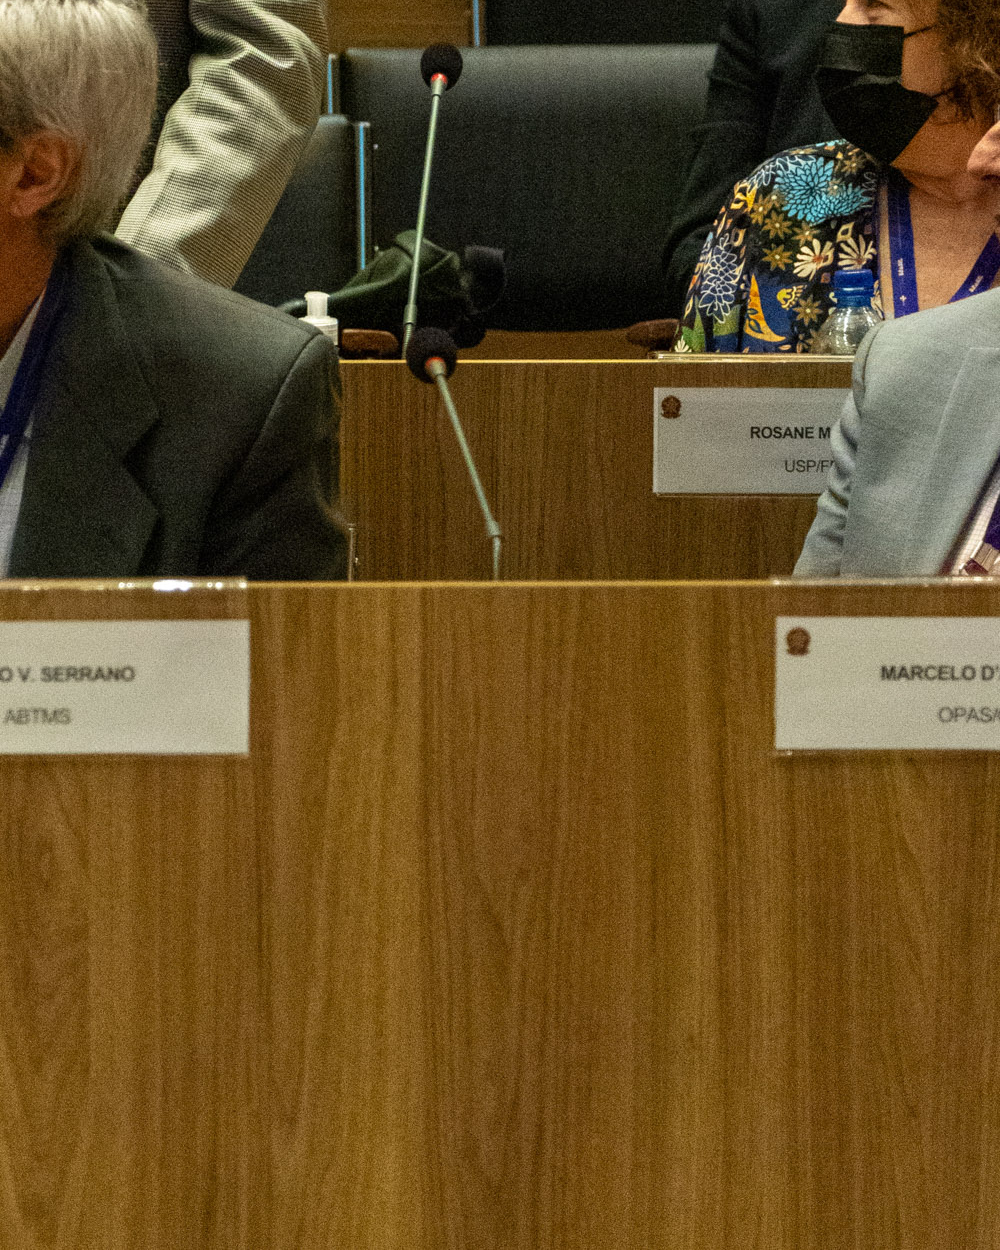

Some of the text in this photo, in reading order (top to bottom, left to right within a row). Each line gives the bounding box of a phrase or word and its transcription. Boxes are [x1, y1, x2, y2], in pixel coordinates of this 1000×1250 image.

[750, 426, 815, 439] ROSANE
[784, 459, 835, 473] USP/F
[16, 666, 34, 682] V.
[40, 665, 136, 682] SERRANO
[880, 664, 977, 681] MARCELO
[2, 706, 71, 724] ABTMS
[937, 706, 1000, 724] OPAS/
